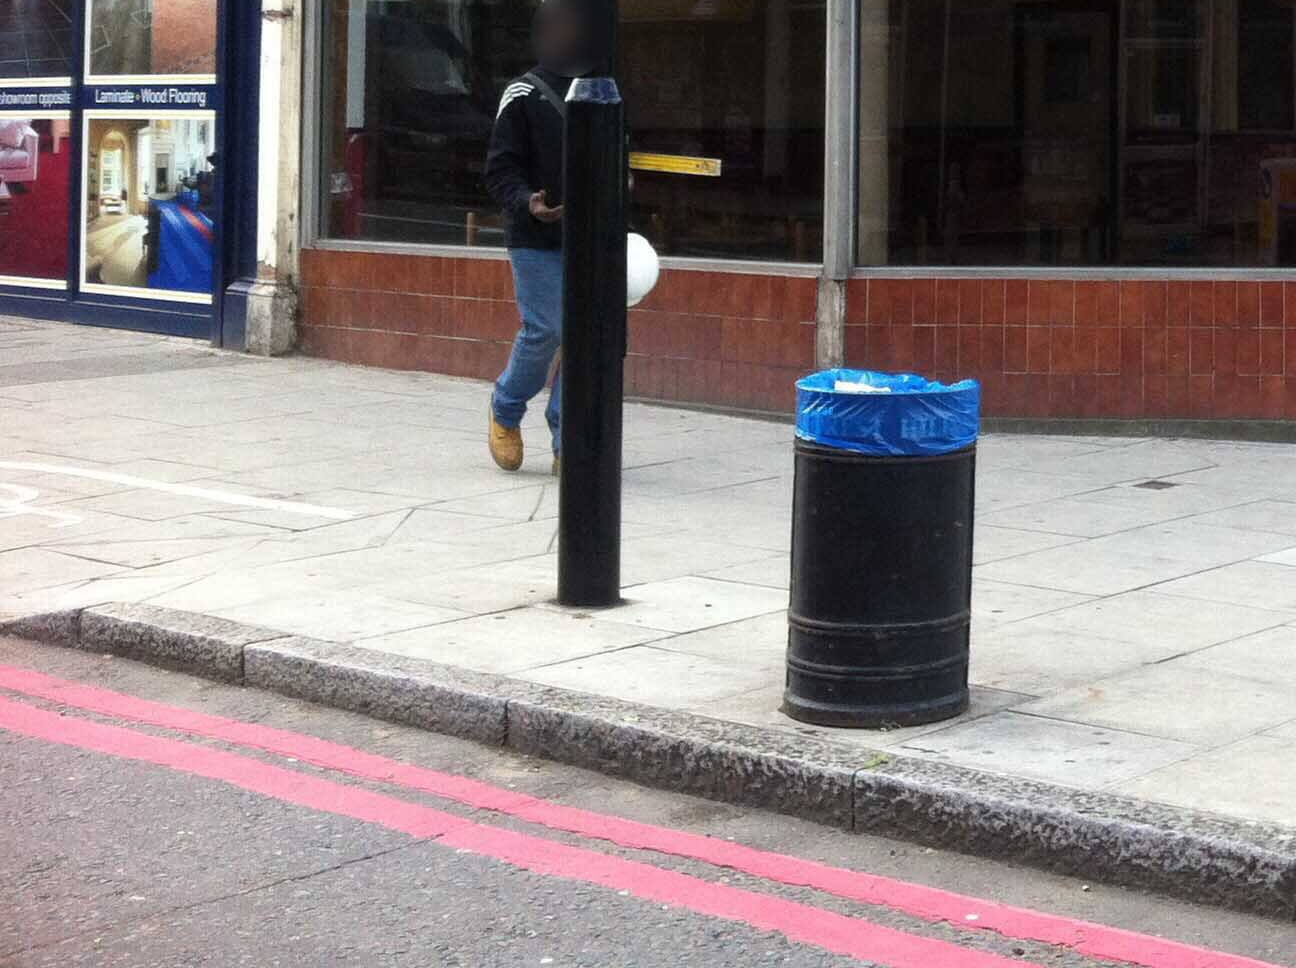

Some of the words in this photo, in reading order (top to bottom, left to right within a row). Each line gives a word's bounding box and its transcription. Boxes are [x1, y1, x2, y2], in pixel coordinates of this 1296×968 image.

[95, 88, 134, 104] Laminate
[141, 87, 168, 104] Wood
[169, 87, 207, 108] Flooring
